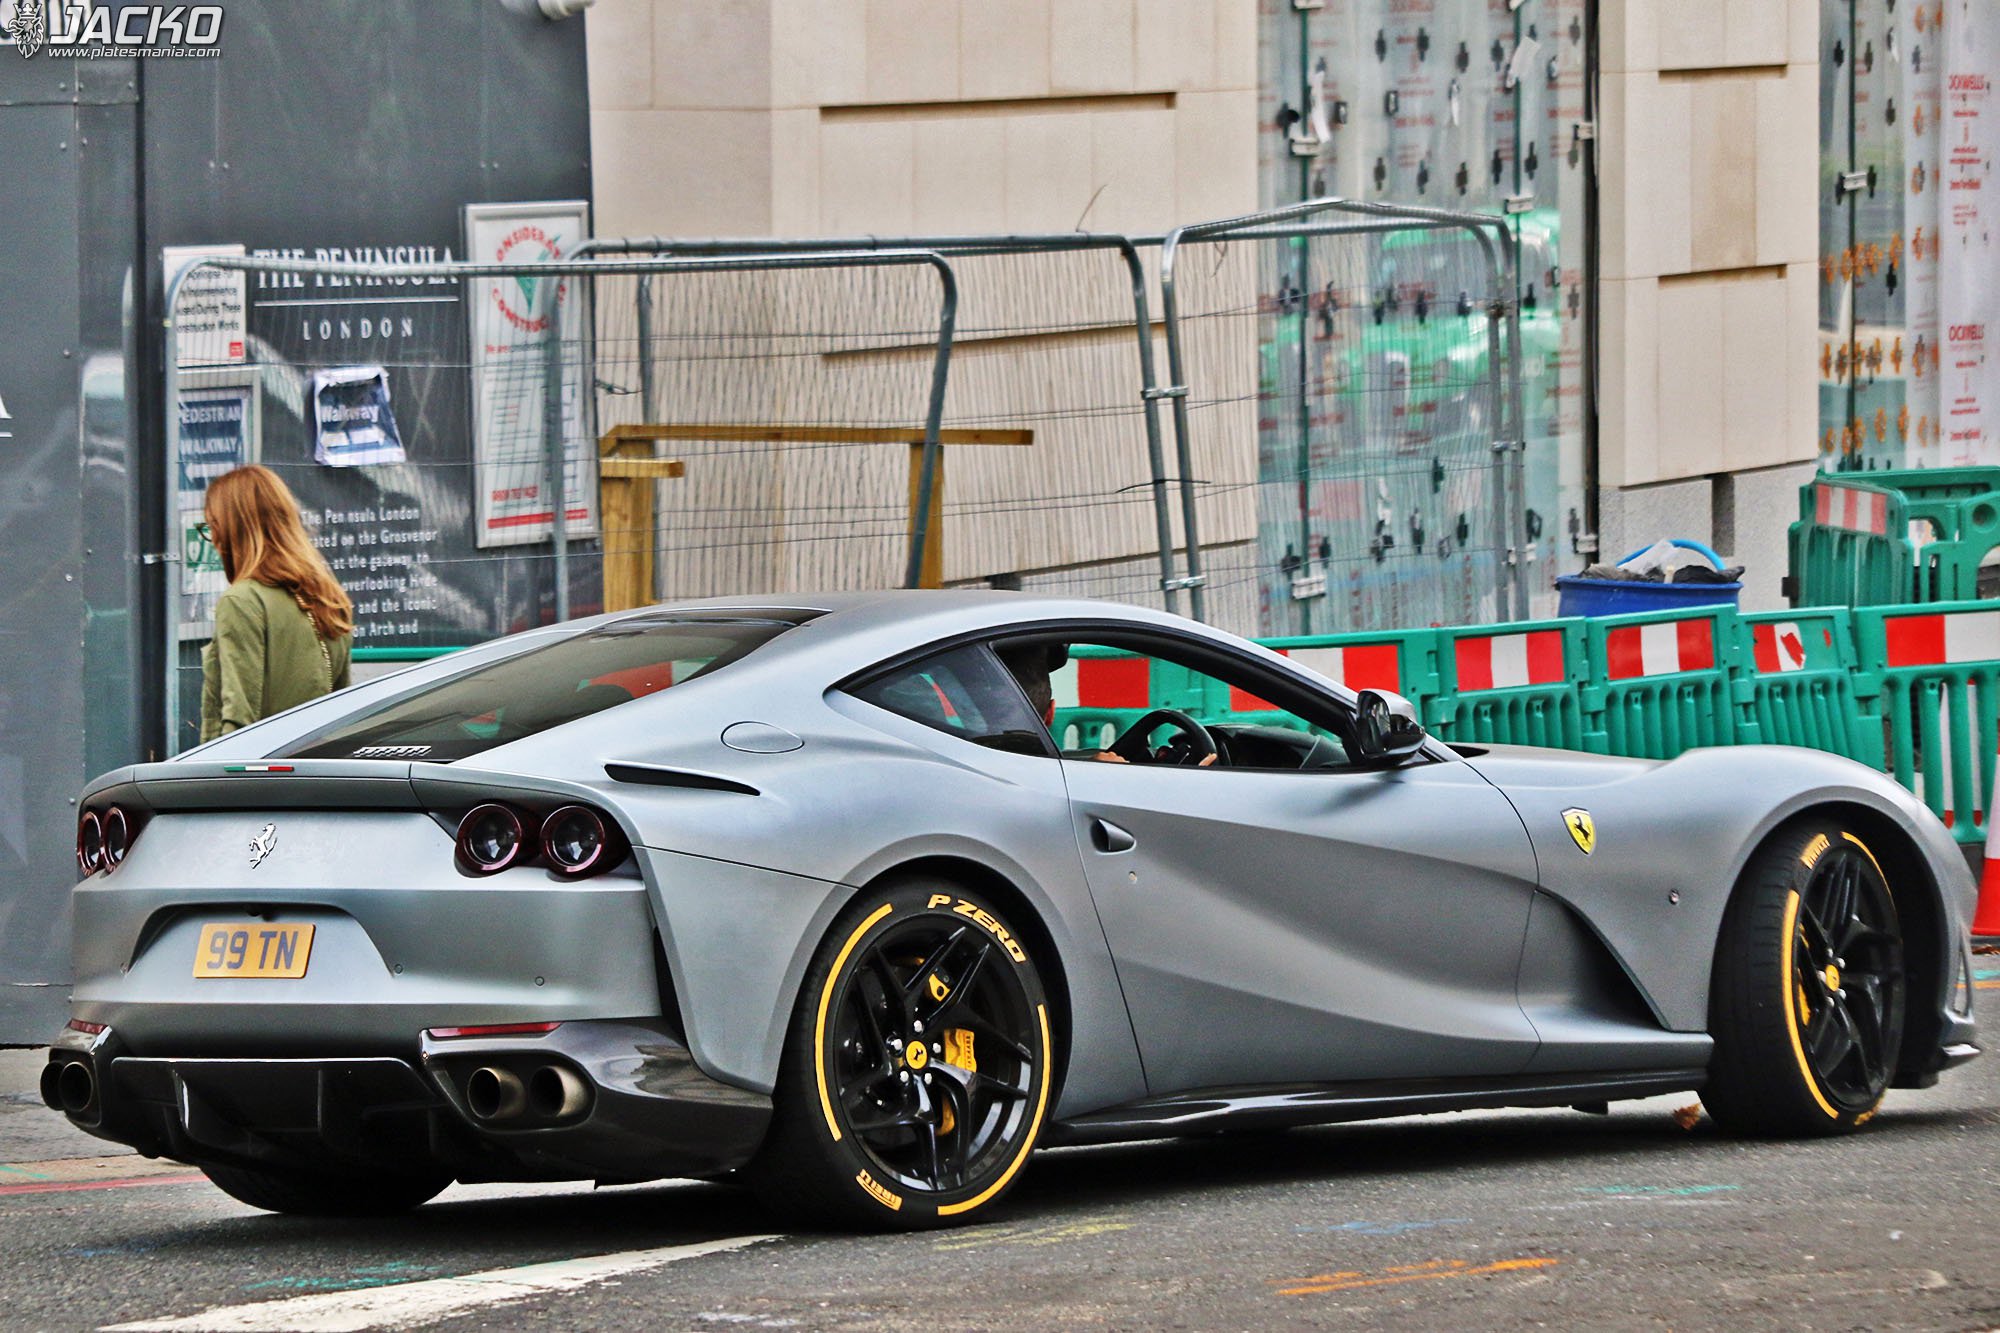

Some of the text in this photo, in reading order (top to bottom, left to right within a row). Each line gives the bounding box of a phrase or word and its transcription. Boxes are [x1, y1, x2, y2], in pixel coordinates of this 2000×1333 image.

[497, 226, 560, 263] ONSIDERAT
[253, 245, 459, 288] THE PENINSULA
[303, 317, 414, 340] LONDON
[177, 405, 241, 424] EDESTRAN
[320, 404, 380, 424] Walkway
[180, 438, 238, 456] WALKWAY
[300, 504, 419, 526] The Pennsula London
[341, 535, 355, 547] on
[358, 530, 376, 546] the
[380, 529, 438, 545] Grosvenor
[333, 556, 345, 570] at
[348, 554, 367, 569] the
[369, 554, 413, 572] gateway
[342, 574, 406, 593] overlooking
[358, 596, 438, 615] and the iconic
[369, 621, 395, 637] Arch
[399, 618, 418, 635] and
[927, 894, 1027, 963] P ZERO
[206, 930, 299, 970] 99 TN
